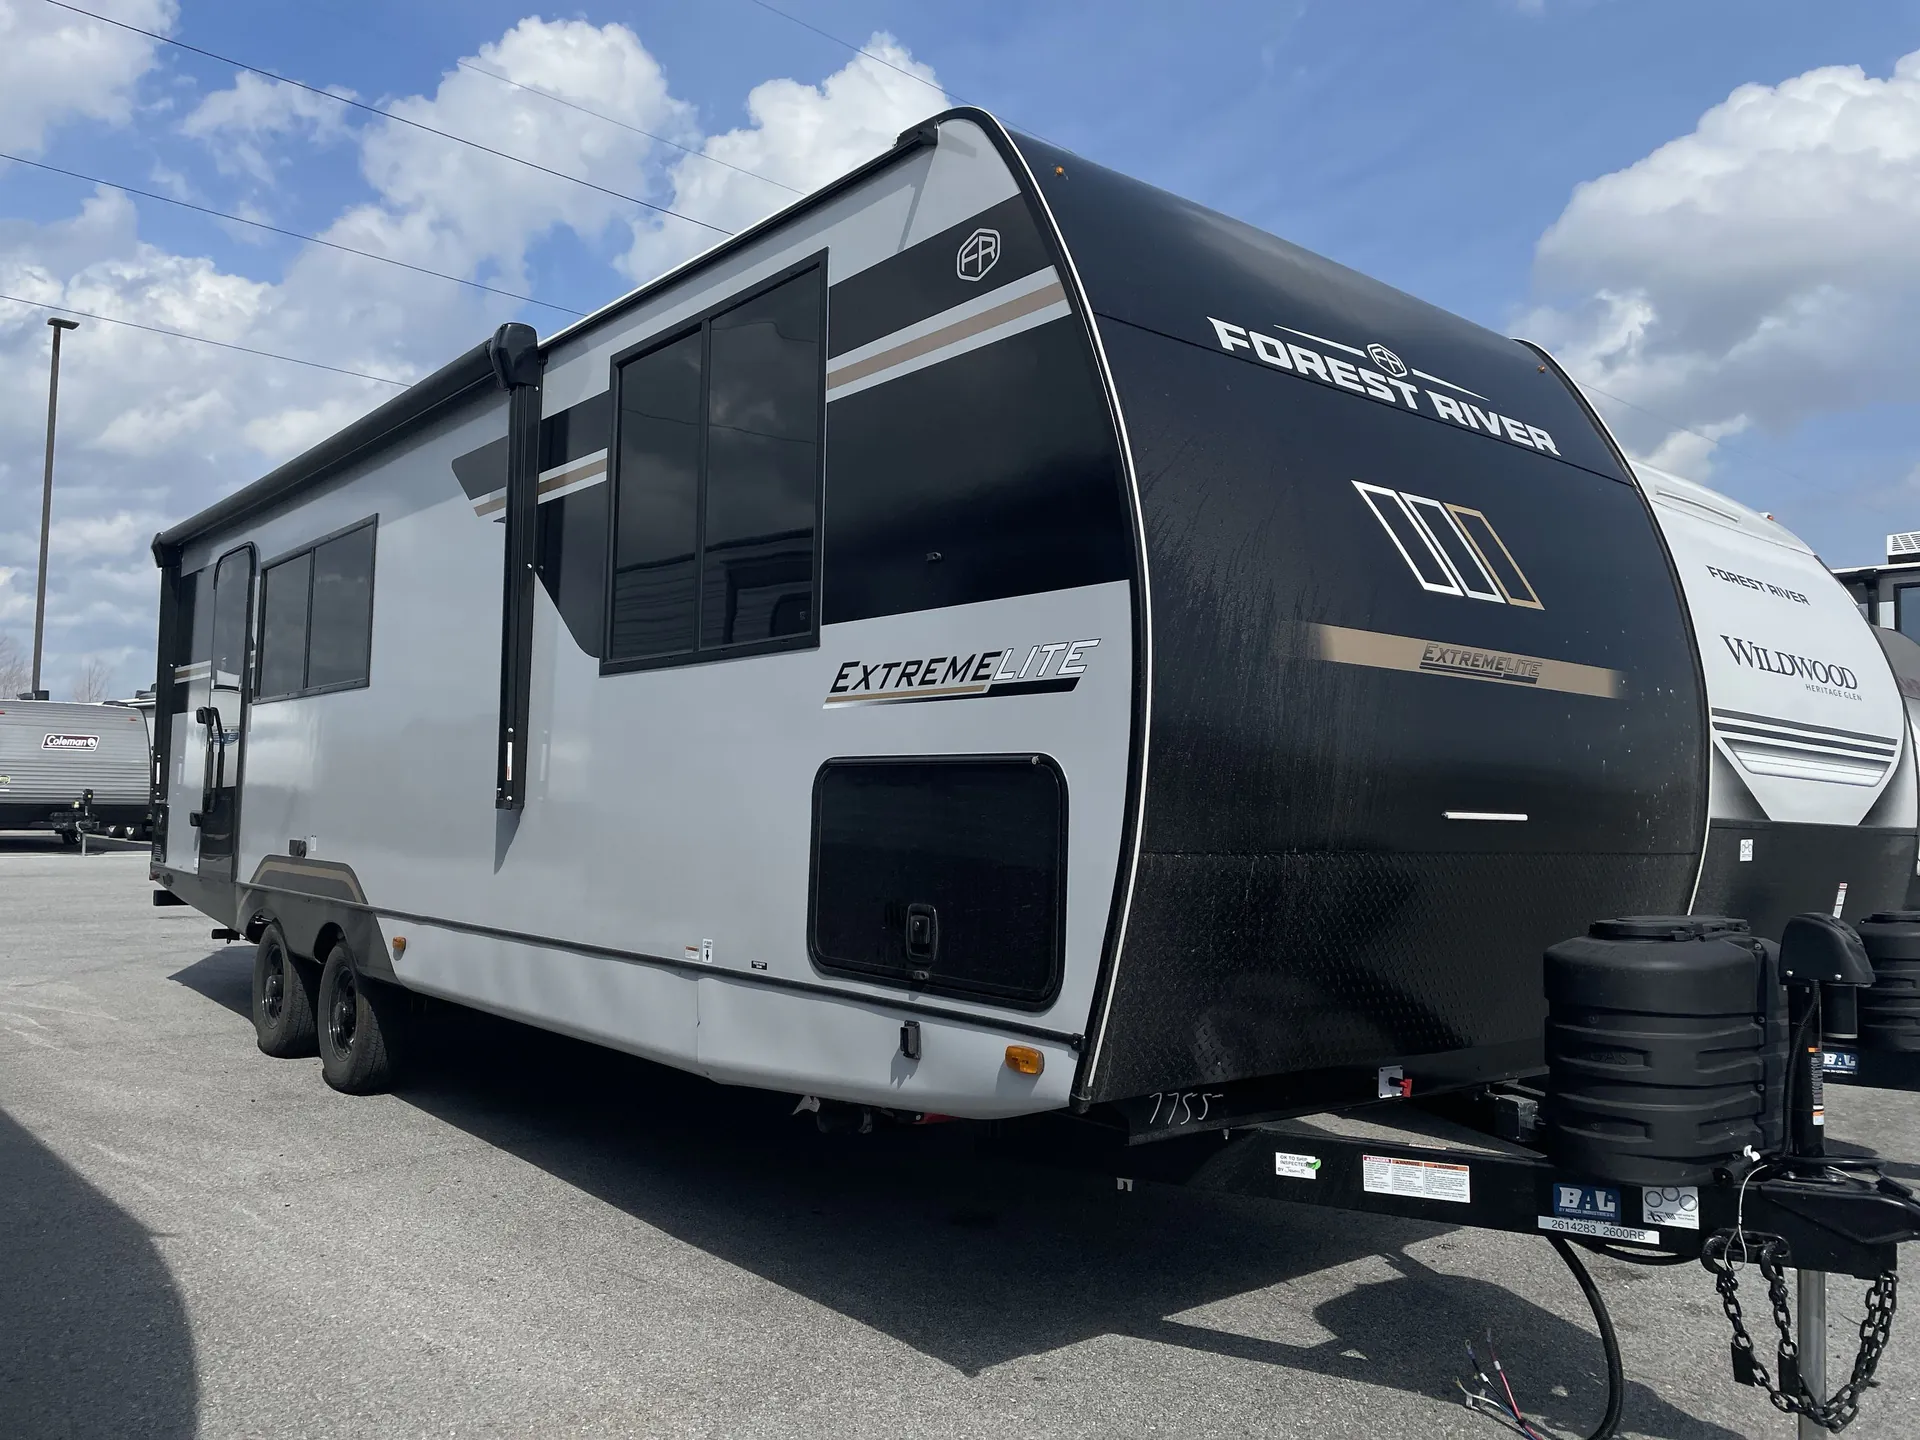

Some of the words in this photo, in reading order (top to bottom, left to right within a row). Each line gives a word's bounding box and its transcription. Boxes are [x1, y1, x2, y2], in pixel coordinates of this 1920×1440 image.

[1206, 316, 1419, 410] FOREST
[1424, 389, 1562, 457] RIVER
[1705, 565, 1766, 593] FOREST
[1765, 583, 1811, 606] RIVER
[1719, 634, 1858, 690] WILDWOOD
[1805, 683, 1843, 698] HERITAGE
[1843, 692, 1863, 702] GLEN
[46, 735, 87, 747] Coleman
[1551, 1219, 1597, 1234] 2614283
[1603, 1226, 1646, 1241] 2600RB
